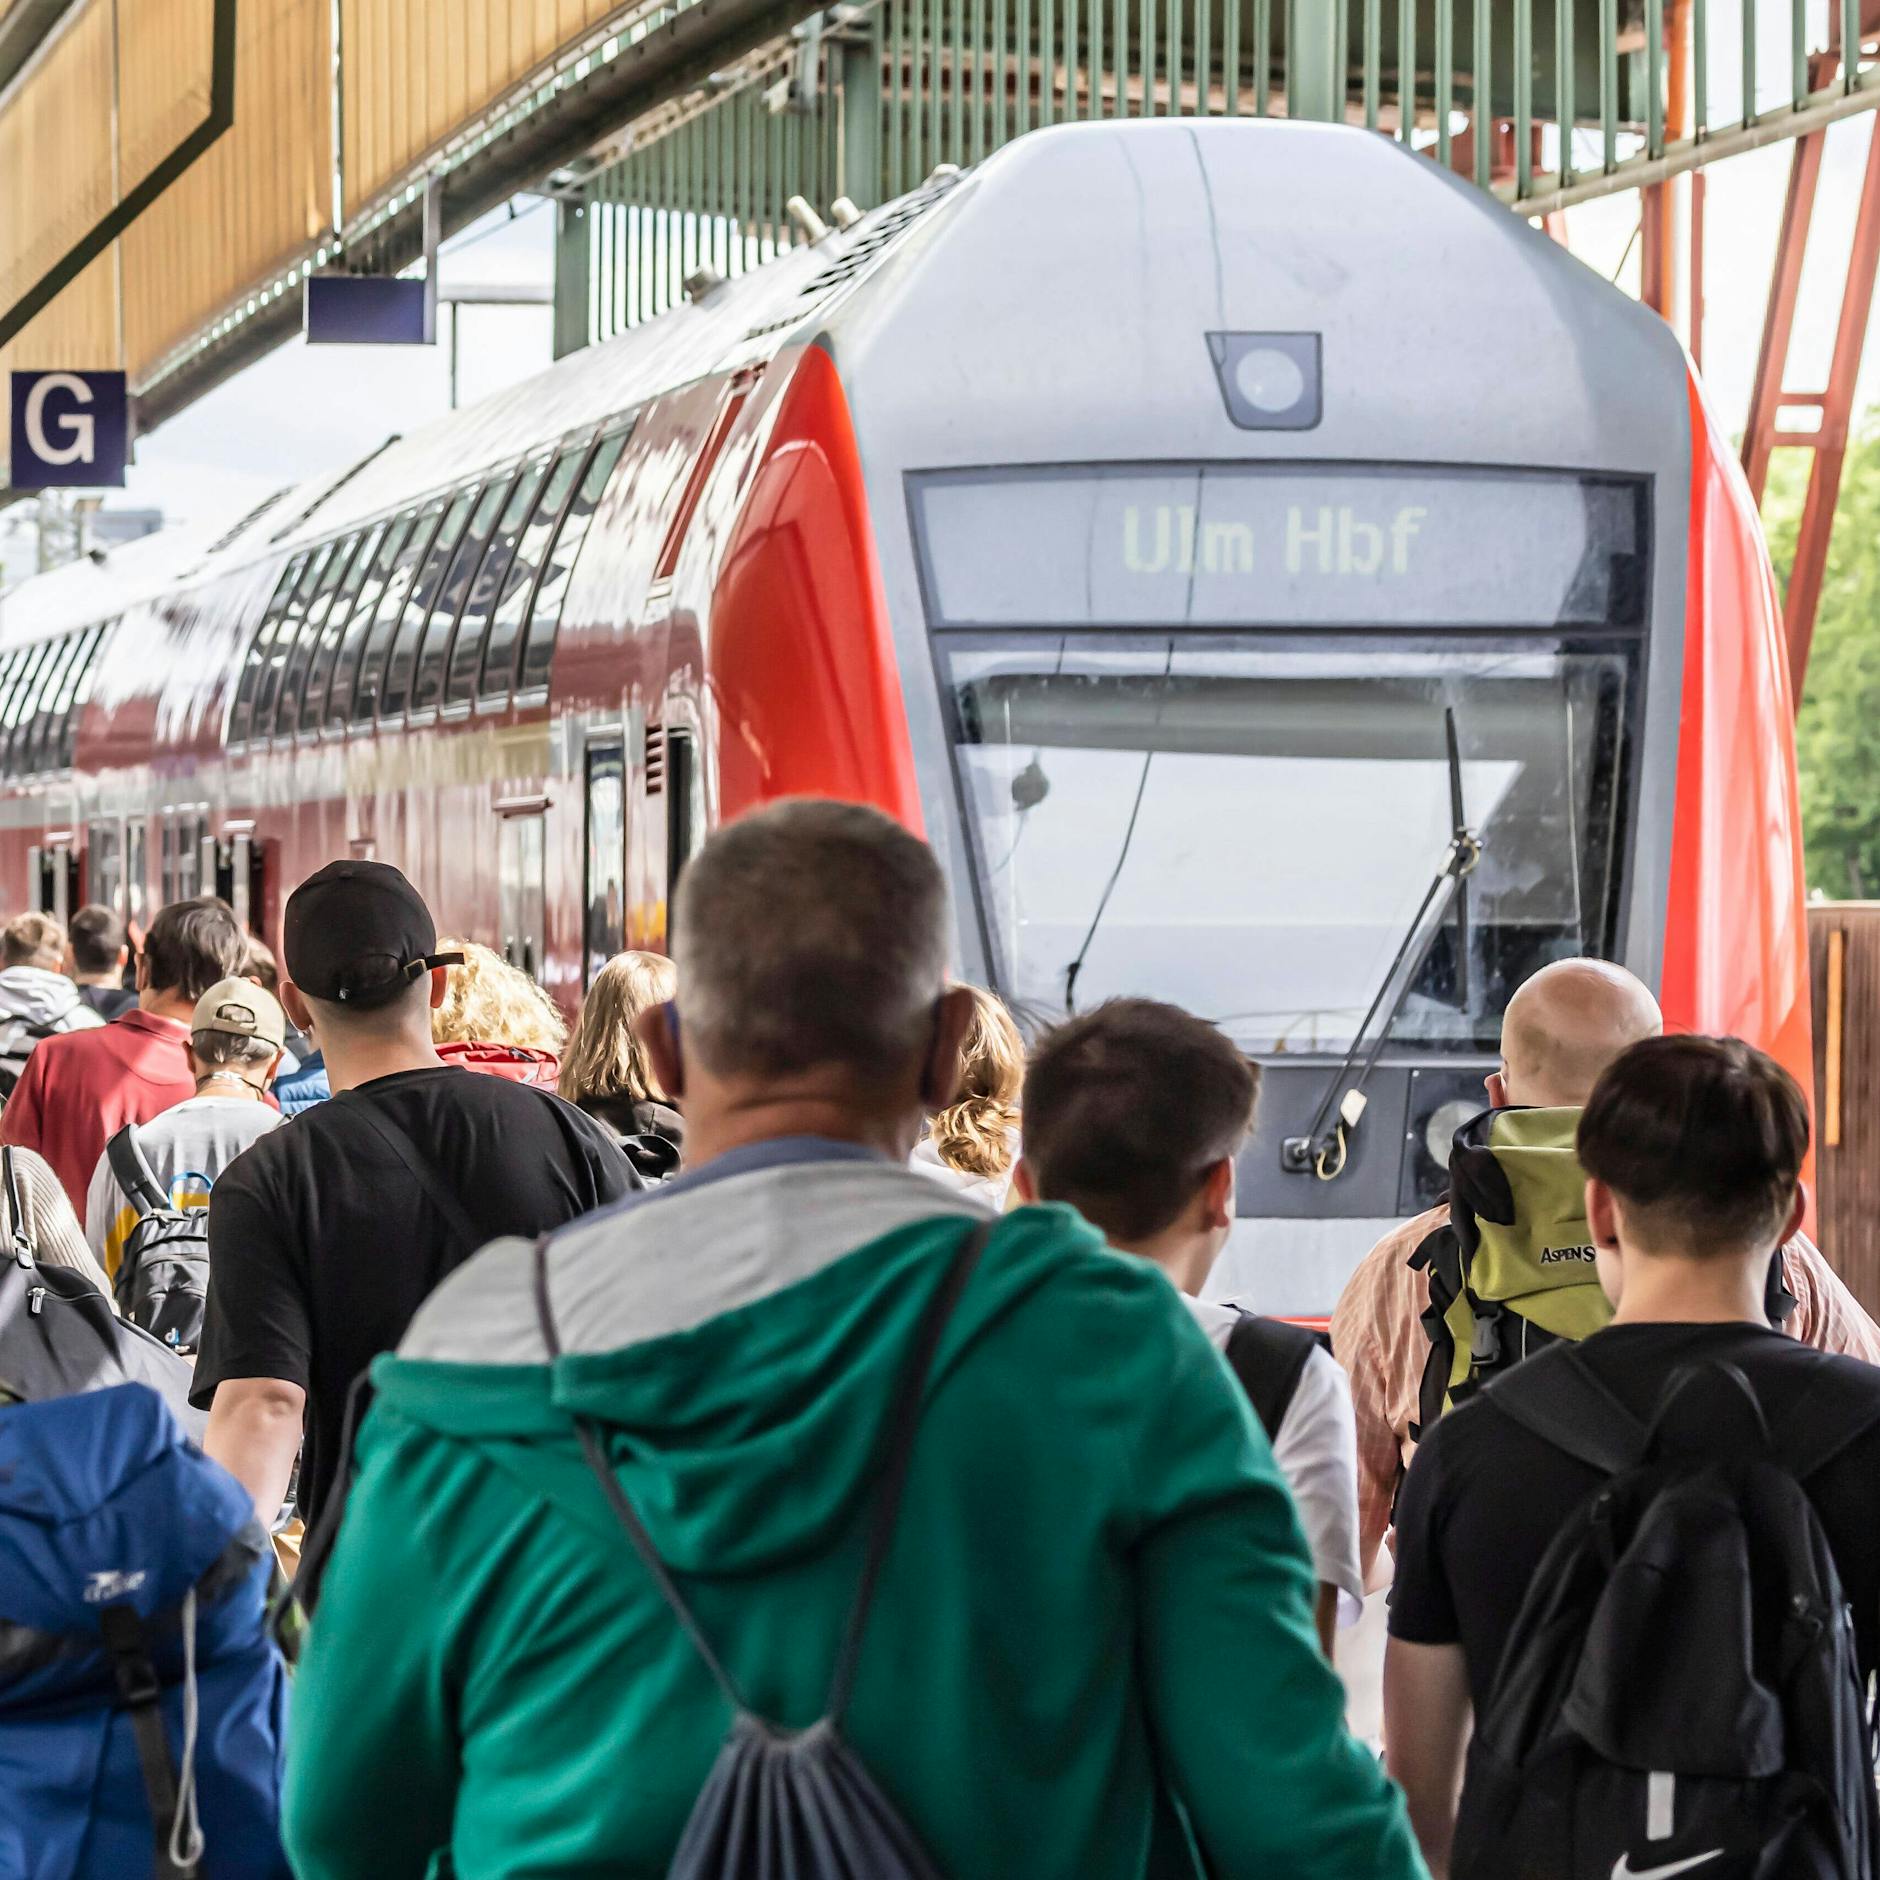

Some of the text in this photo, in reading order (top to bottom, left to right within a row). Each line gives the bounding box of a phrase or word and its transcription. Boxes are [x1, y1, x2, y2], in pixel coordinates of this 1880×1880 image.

[25, 373, 95, 465] G
[1123, 505, 1427, 574] Ulm Hbf
